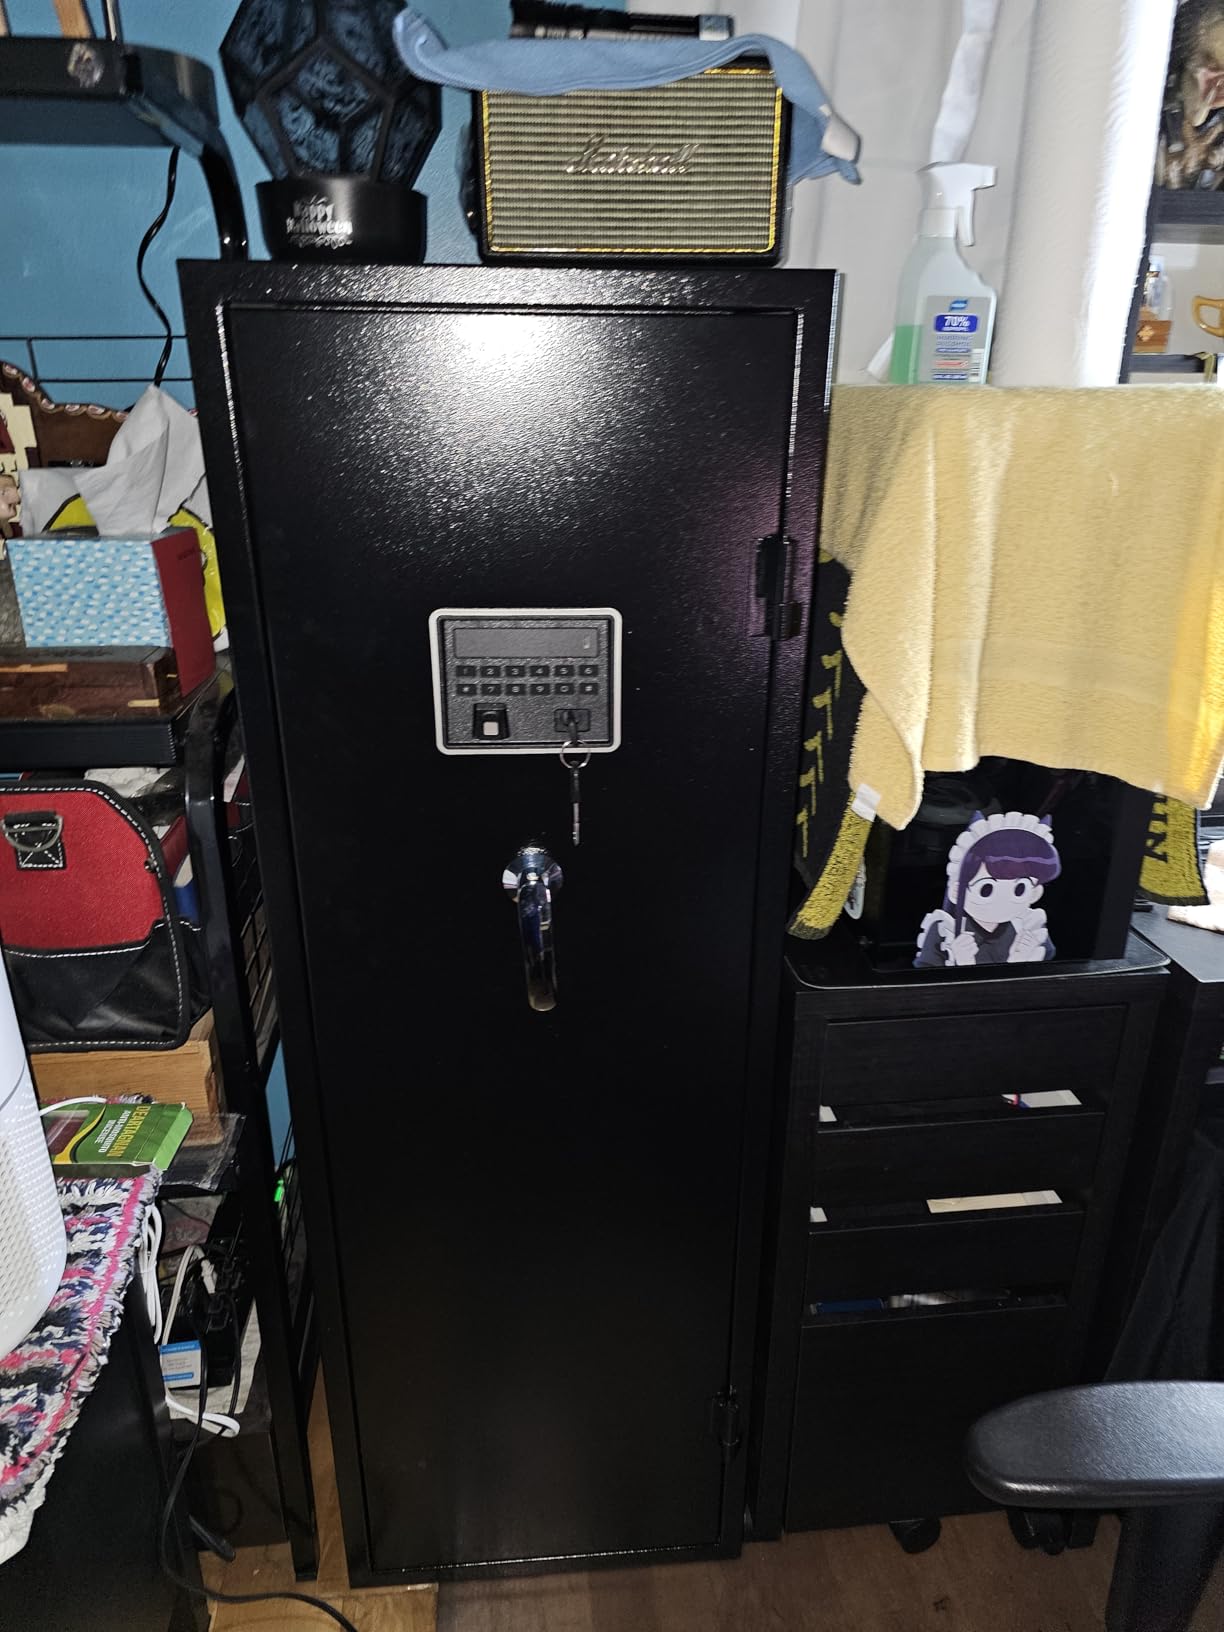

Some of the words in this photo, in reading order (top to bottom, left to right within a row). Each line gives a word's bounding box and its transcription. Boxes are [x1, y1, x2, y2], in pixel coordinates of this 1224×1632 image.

[944, 316, 971, 327] 70%
[486, 668, 495, 676] 2
[511, 668, 519, 676] 3
[559, 667, 569, 675] 5
[584, 667, 593, 675] 6
[535, 685, 545, 693] 9
[559, 685, 569, 693] 0
[94, 1119, 115, 1144] INCENSE
[98, 1110, 132, 1153] ANTI-MOSQUITO
[106, 1105, 152, 1157] DEARTAGNAN
